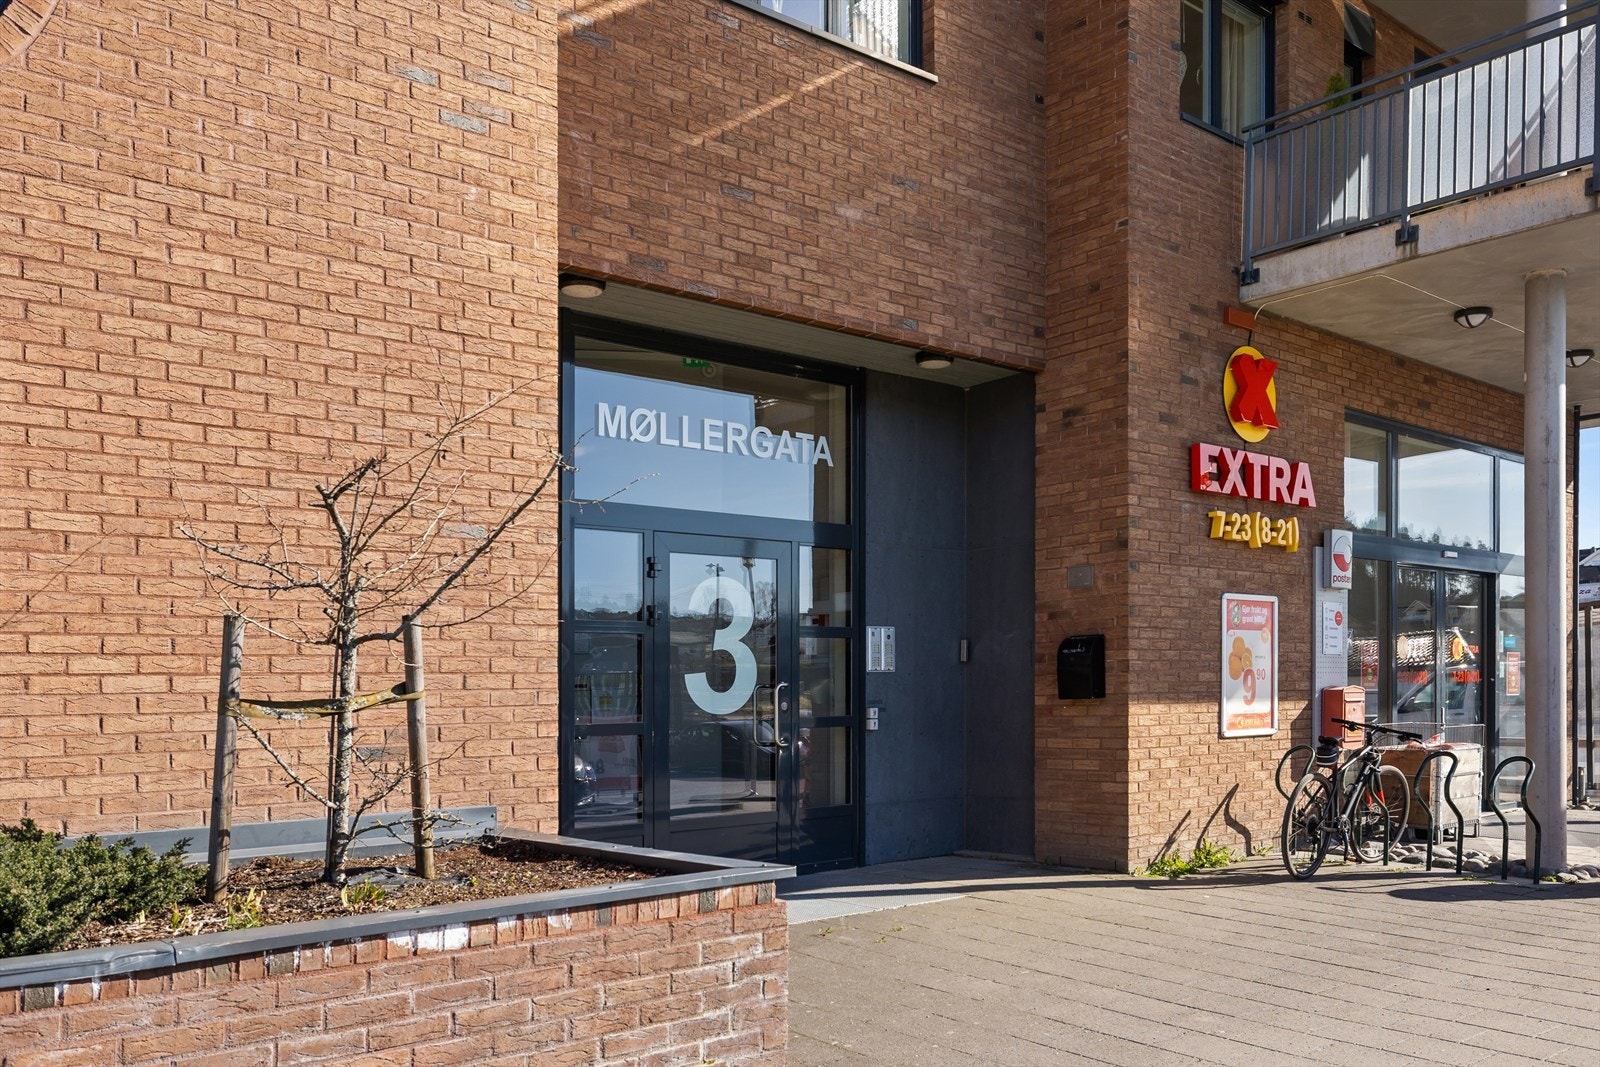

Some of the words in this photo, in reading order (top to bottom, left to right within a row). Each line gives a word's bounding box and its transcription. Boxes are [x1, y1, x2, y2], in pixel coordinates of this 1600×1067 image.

[596, 402, 834, 468] MØLLERGATA
[1191, 442, 1317, 508] EXTRA
[1332, 574, 1352, 584] poste
[684, 576, 758, 715] 3
[1242, 668, 1257, 706] 9
[1256, 668, 1266, 681] 90
